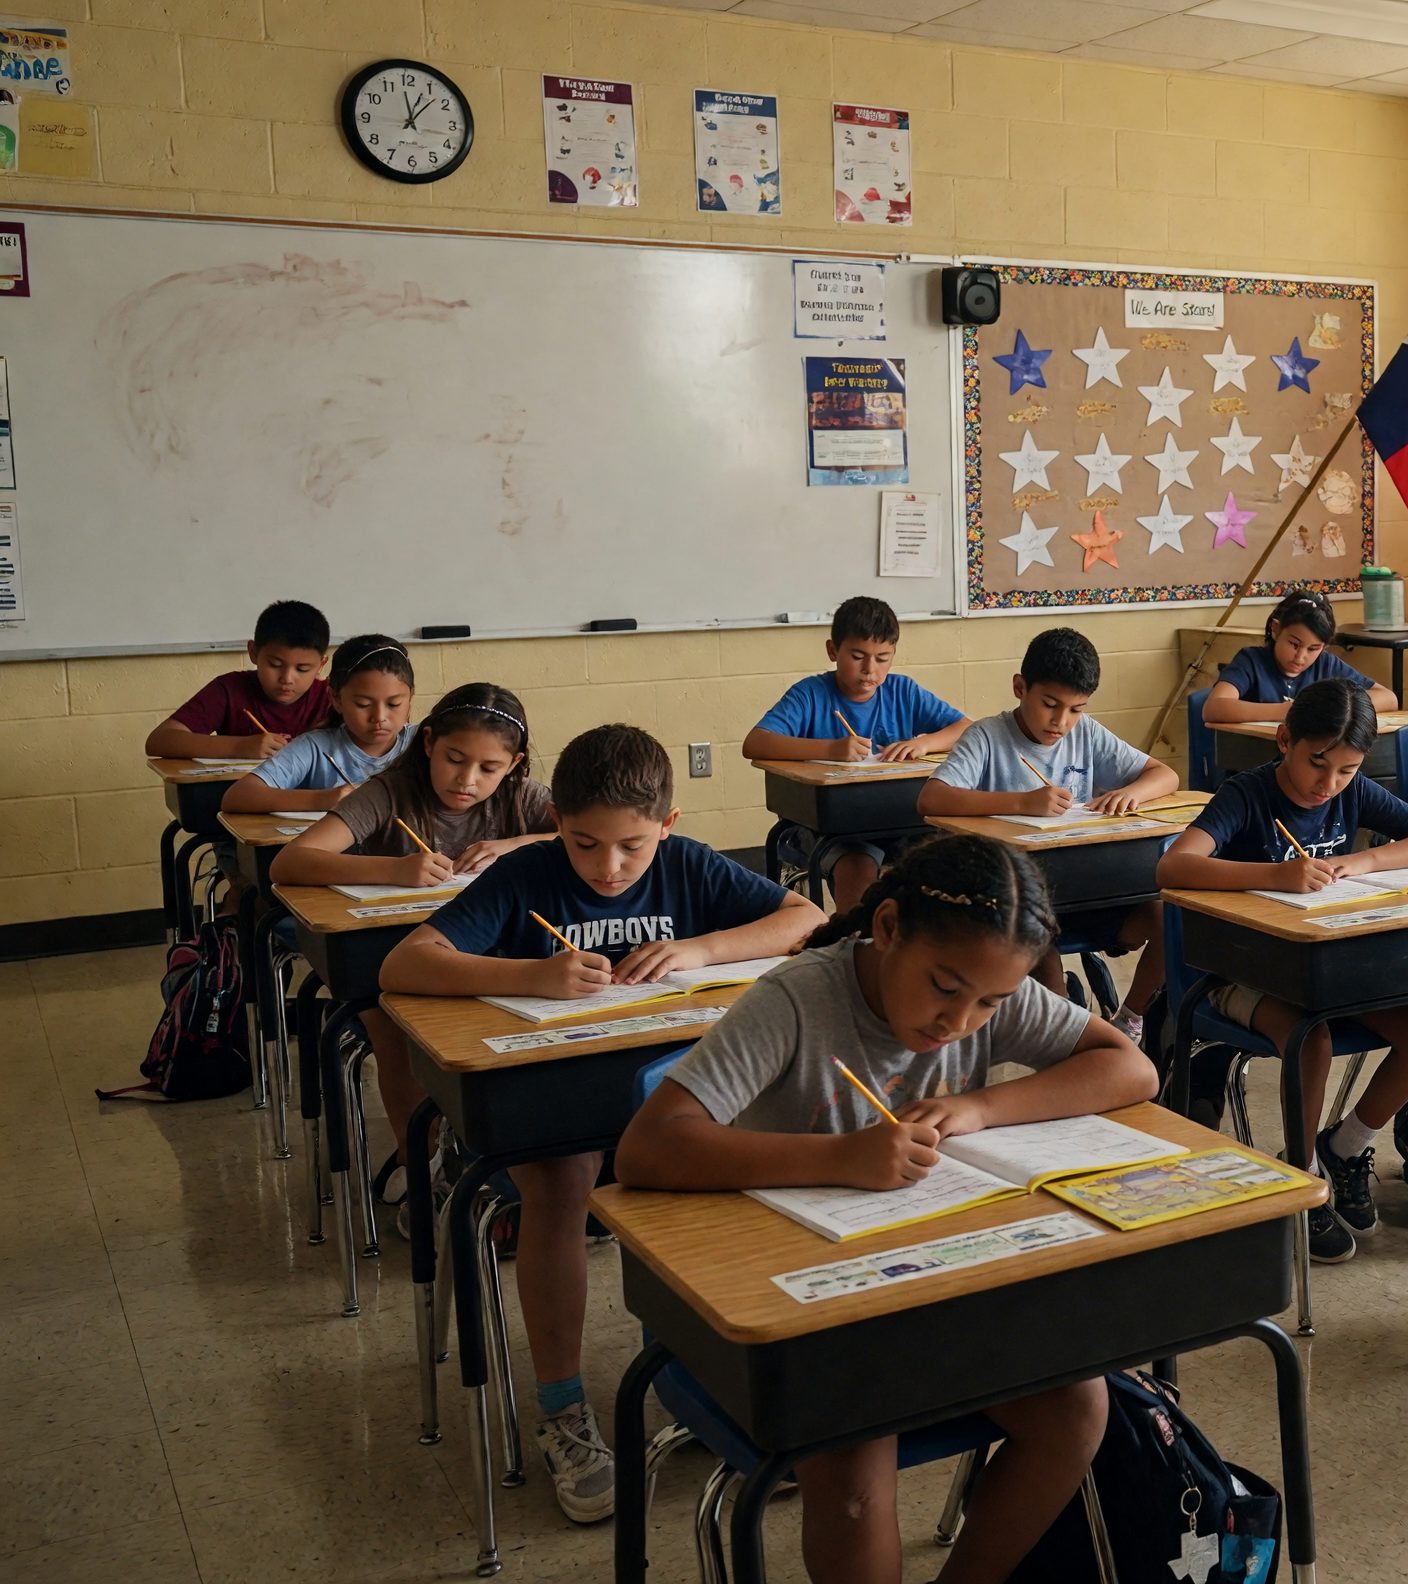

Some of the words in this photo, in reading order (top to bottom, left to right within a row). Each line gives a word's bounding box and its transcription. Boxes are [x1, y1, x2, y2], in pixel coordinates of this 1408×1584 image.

[383, 80, 394, 92] 11
[401, 73, 416, 88] 12
[427, 82, 432, 95] 1
[368, 92, 382, 105] 10
[440, 98, 450, 111] 2
[361, 112, 371, 123] 9
[448, 120, 457, 131] 3
[369, 133, 379, 145] 8
[443, 138, 452, 149] 4
[387, 148, 396, 160] 7
[428, 151, 438, 163] 5
[407, 155, 417, 168] 6
[1154, 301, 1177, 316] Are
